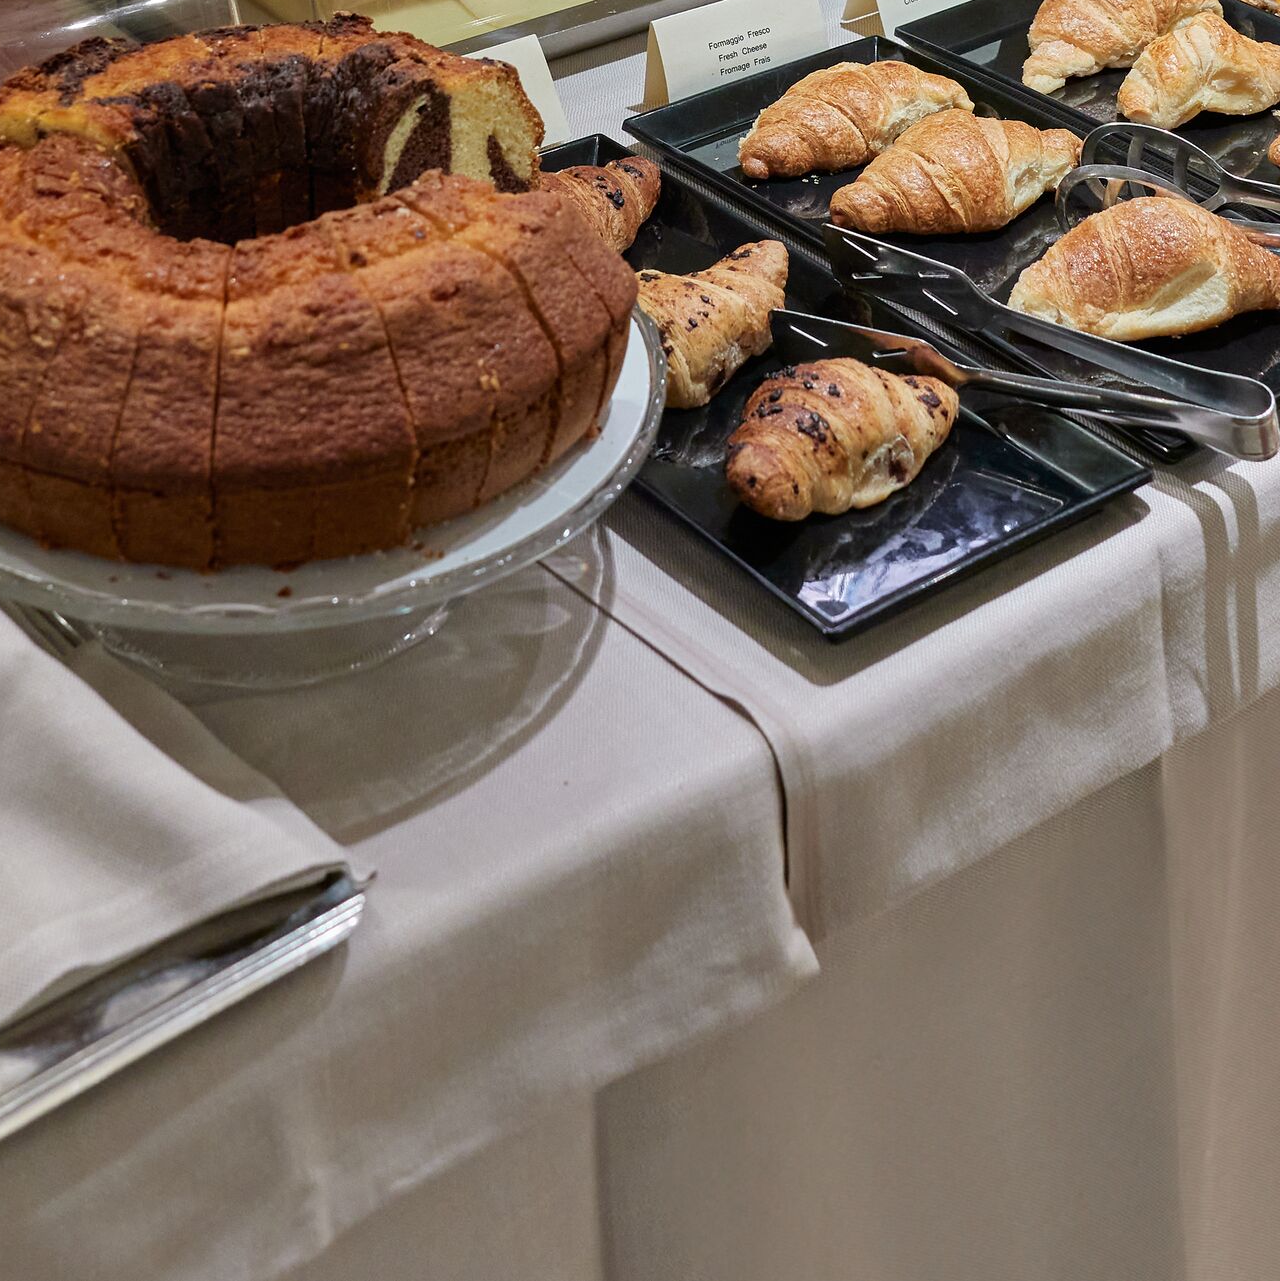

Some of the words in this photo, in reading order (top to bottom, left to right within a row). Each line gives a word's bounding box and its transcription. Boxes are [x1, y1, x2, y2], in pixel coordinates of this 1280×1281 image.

[708, 34, 744, 50] Formaggio
[747, 26, 771, 39] Fresco
[718, 51, 738, 62] Fresh
[741, 42, 768, 55] Cheese
[720, 62, 750, 76] Fromage
[753, 55, 771, 67] Frais
